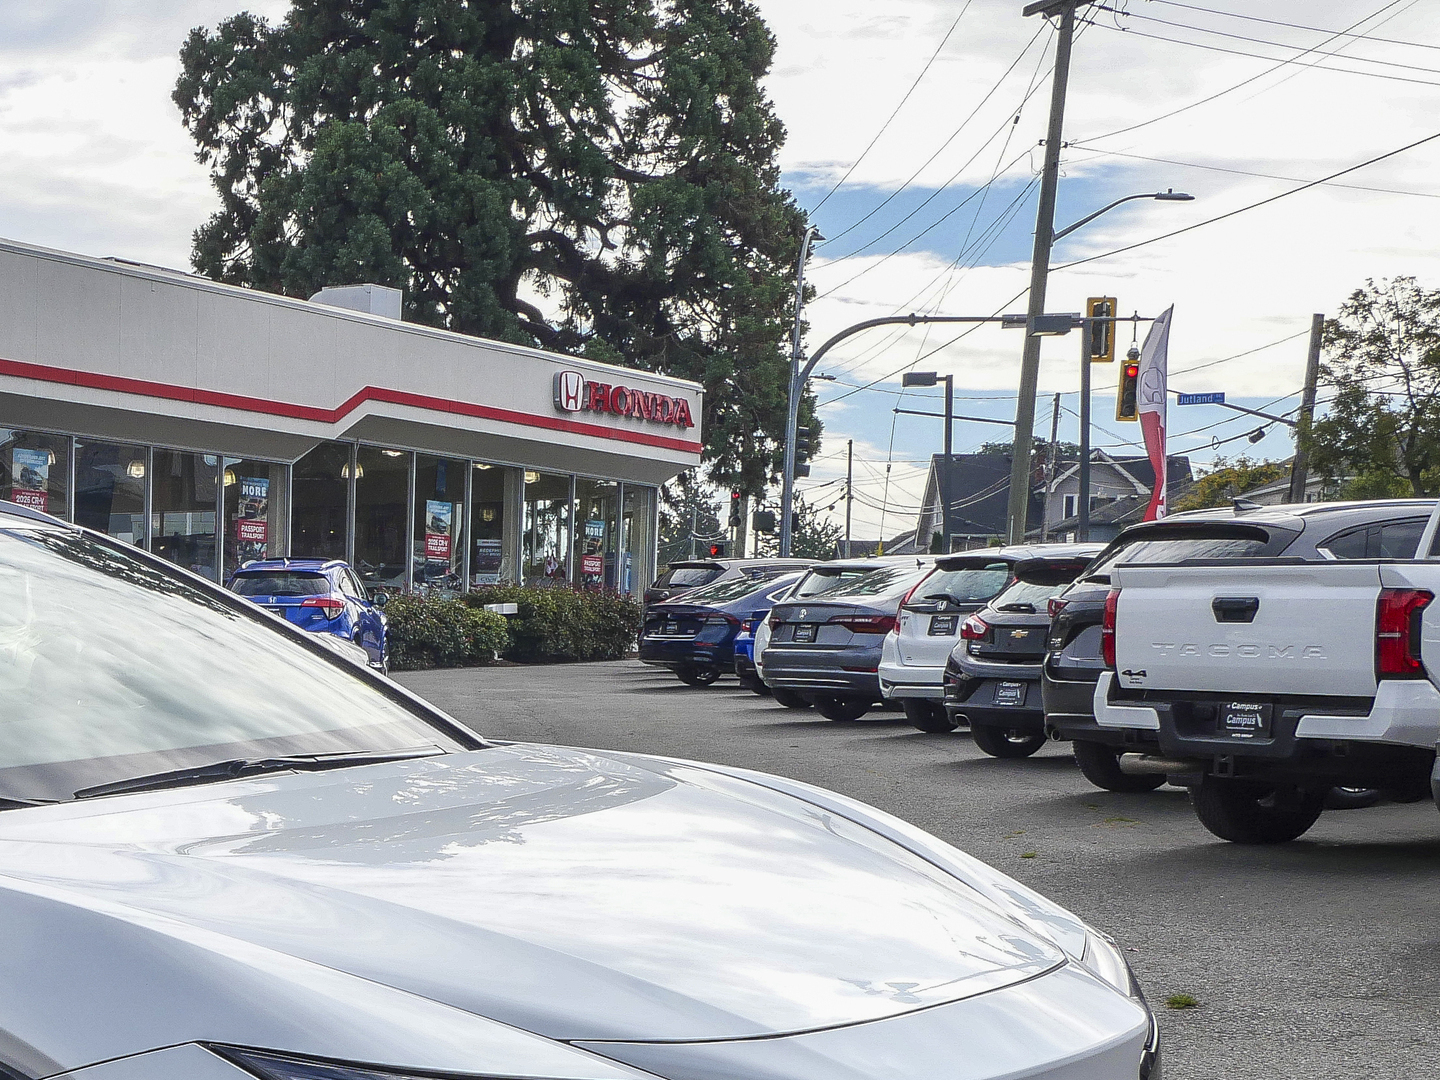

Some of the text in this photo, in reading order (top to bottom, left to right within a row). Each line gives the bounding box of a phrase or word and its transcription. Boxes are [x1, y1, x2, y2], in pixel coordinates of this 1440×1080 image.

[586, 380, 695, 428] HONDA
[1180, 394, 1213, 404] Jutland
[242, 484, 267, 497] MORE
[15, 494, 31, 504] 2026
[241, 524, 265, 534] PASSPORT
[1151, 642, 1328, 660] TACOMA
[1231, 701, 1259, 711] Campus
[1226, 714, 1256, 727] Campus
